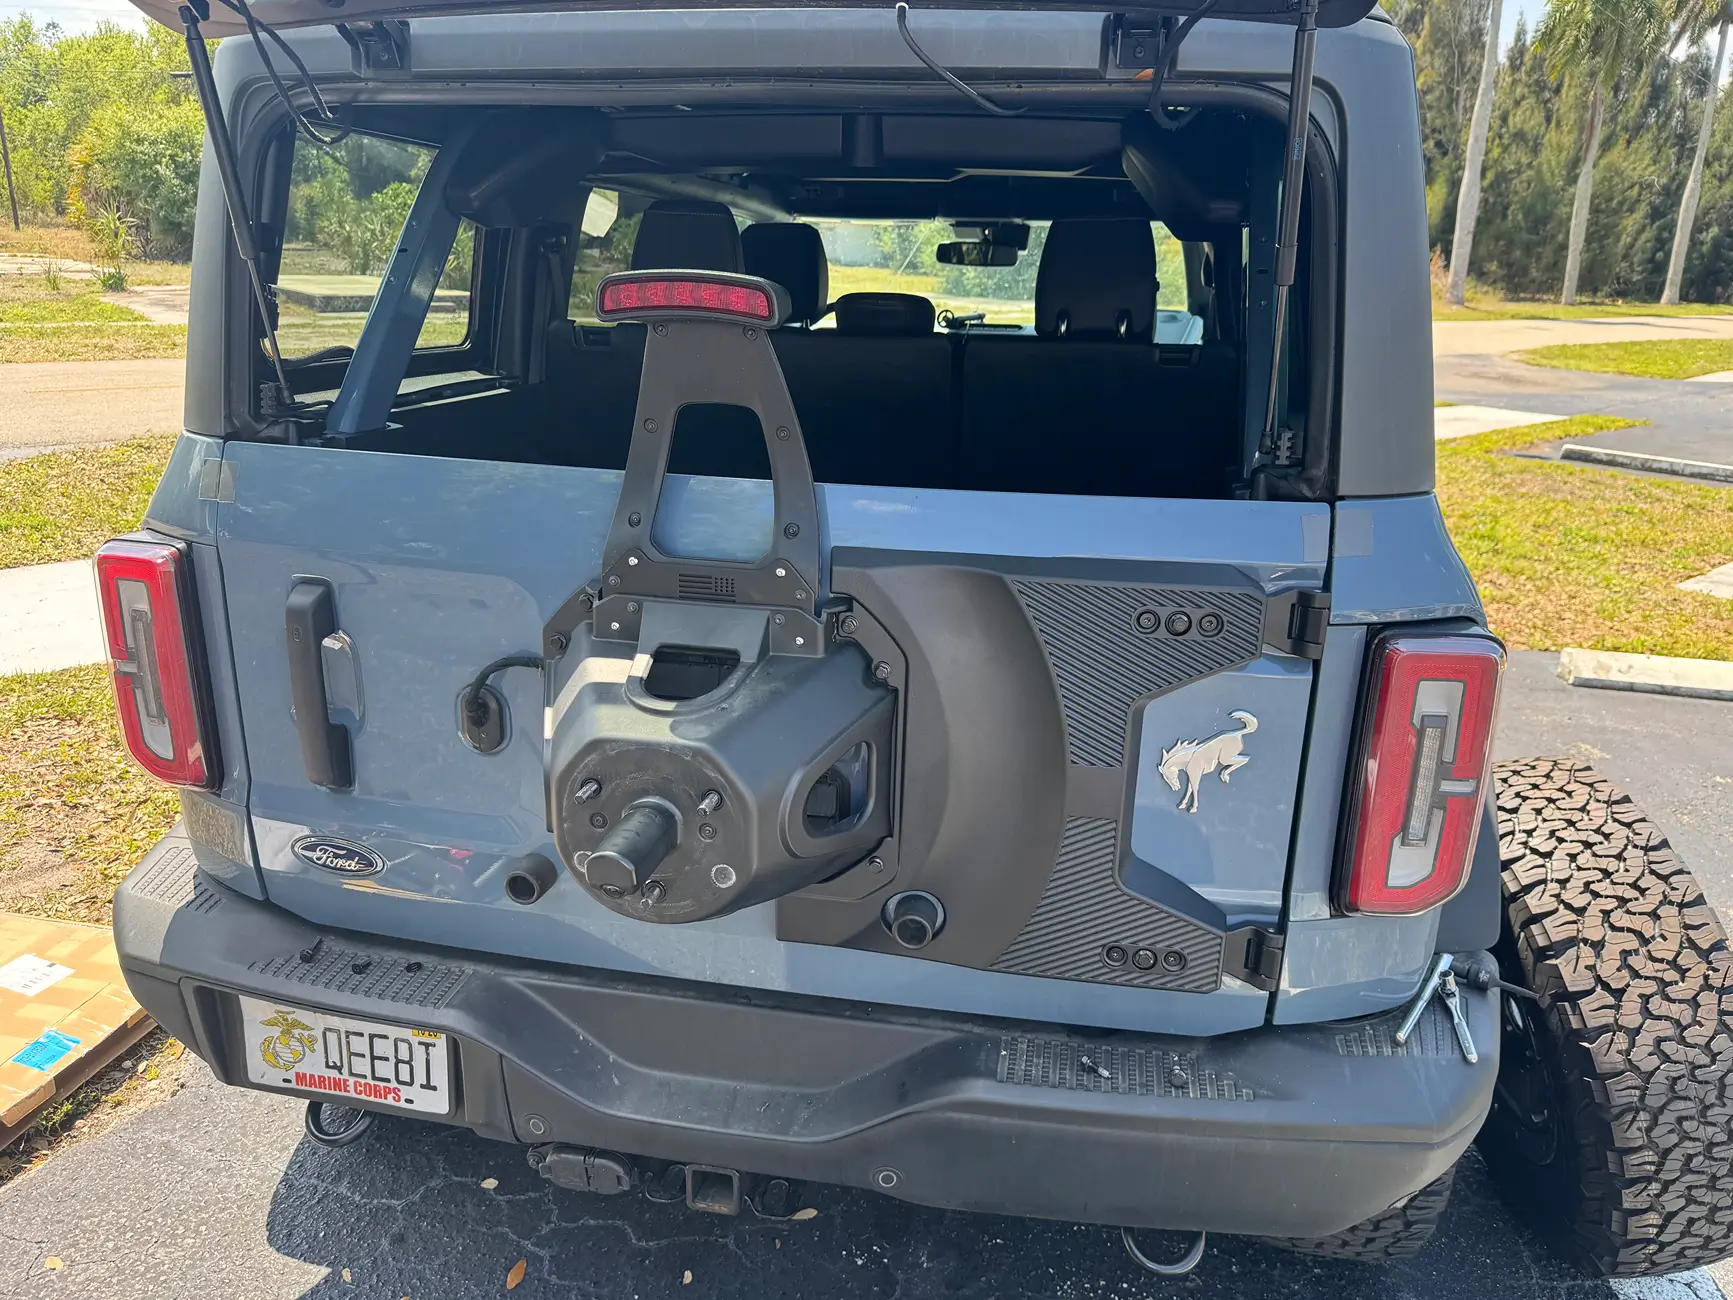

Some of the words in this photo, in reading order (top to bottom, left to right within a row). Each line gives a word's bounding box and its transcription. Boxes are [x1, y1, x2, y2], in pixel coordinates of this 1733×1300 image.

[313, 845, 368, 870] Ford
[295, 1071, 350, 1093] MARINE
[353, 1079, 402, 1103] CORPS
